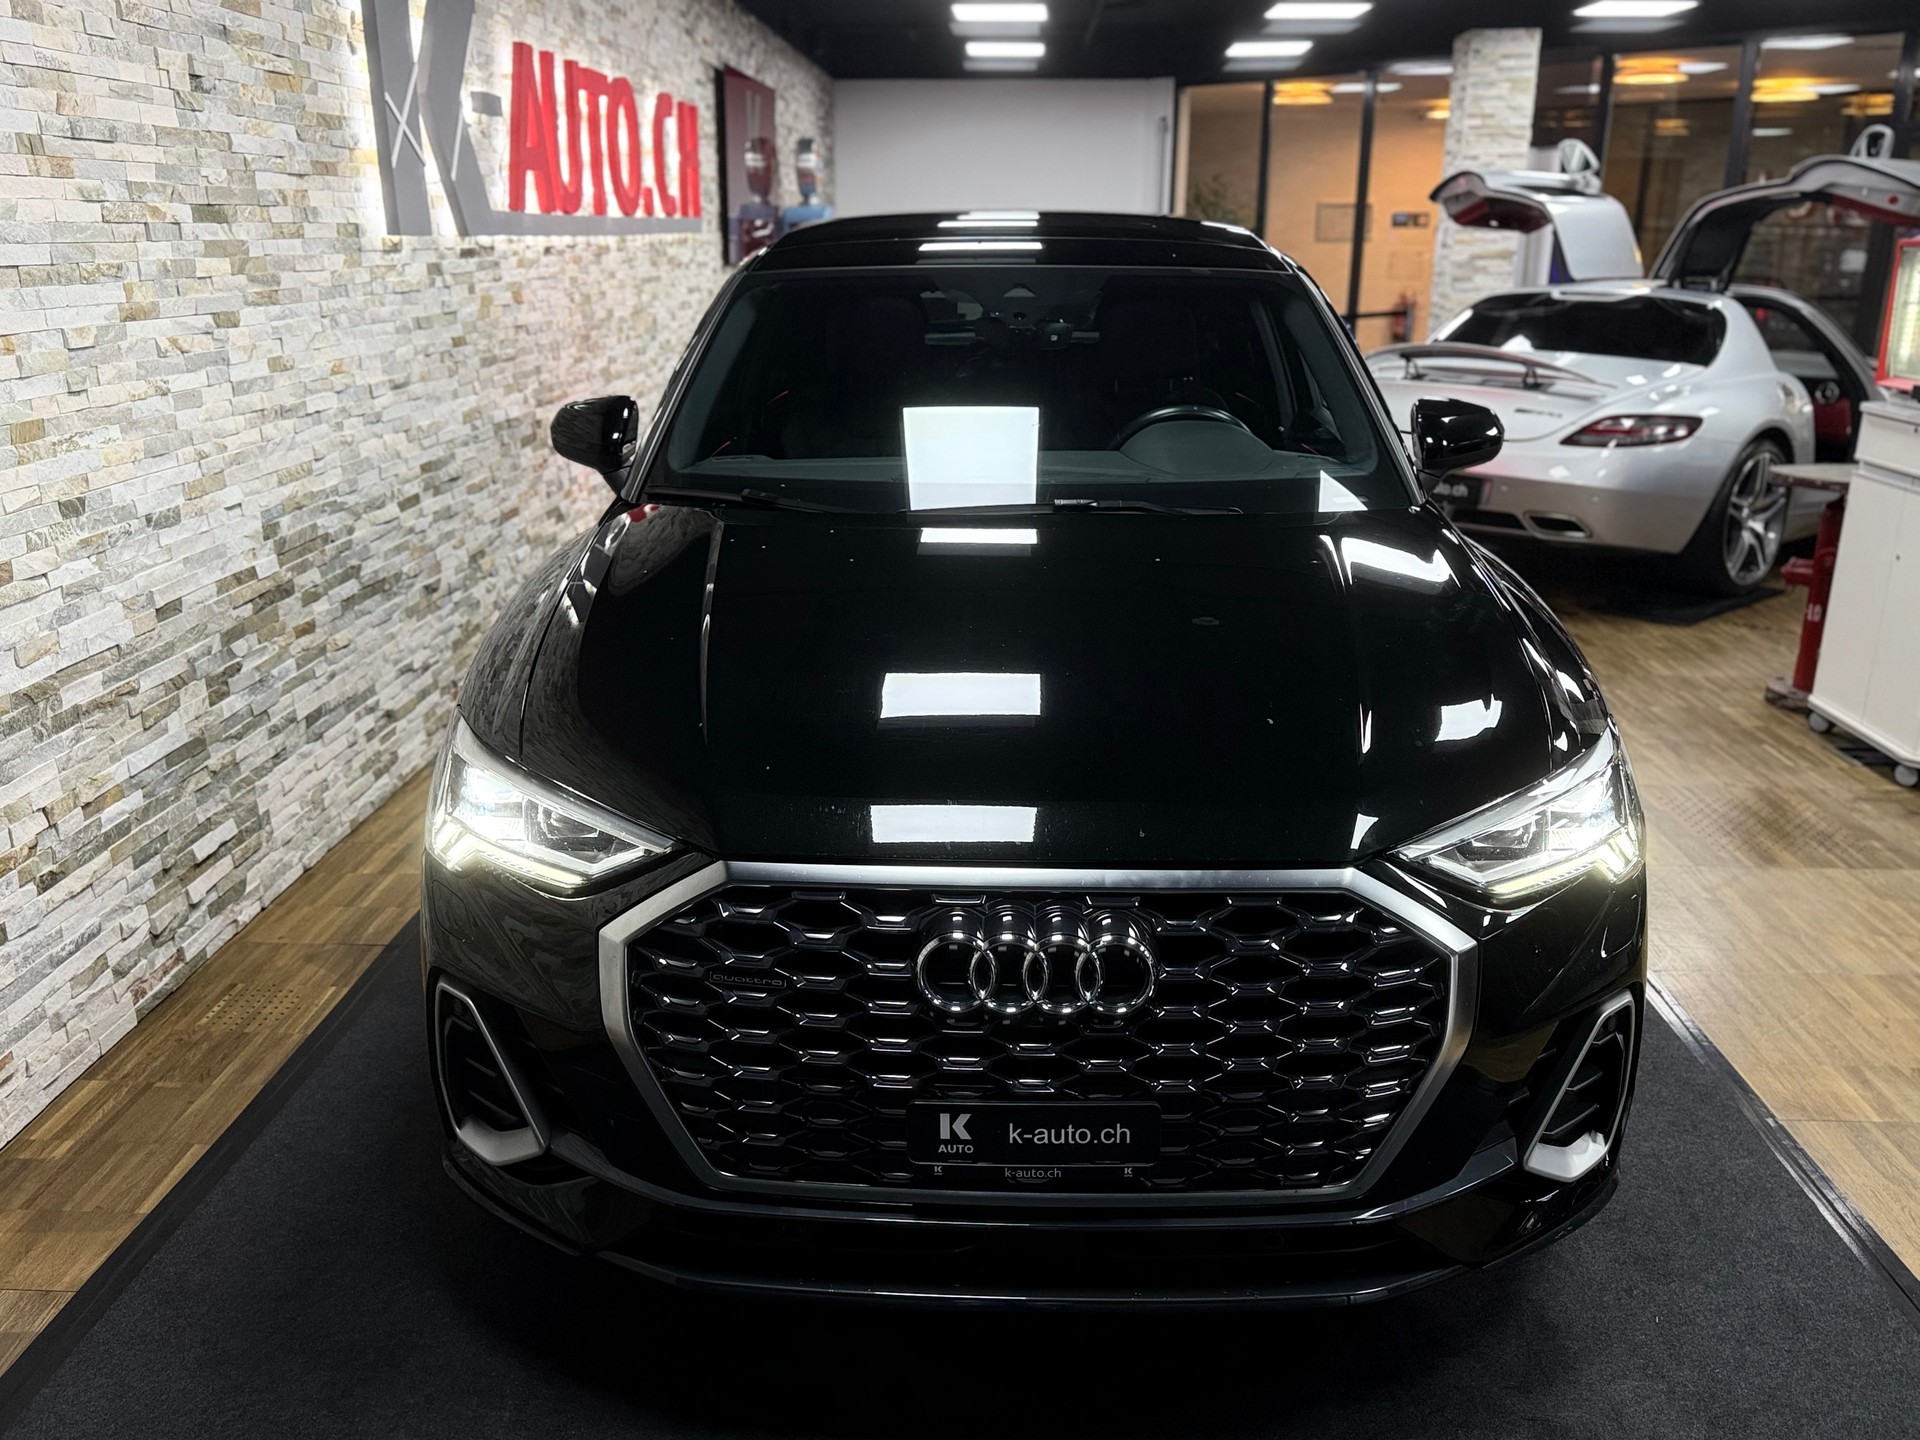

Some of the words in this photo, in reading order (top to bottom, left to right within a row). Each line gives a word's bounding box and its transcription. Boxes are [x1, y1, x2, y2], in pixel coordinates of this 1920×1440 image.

[712, 974, 783, 987] quattro
[939, 1113, 972, 1140] K
[1009, 1123, 1131, 1144] k-auto.ch
[938, 1144, 974, 1154] AUTO
[1004, 1167, 1062, 1179] k-auto.ch
